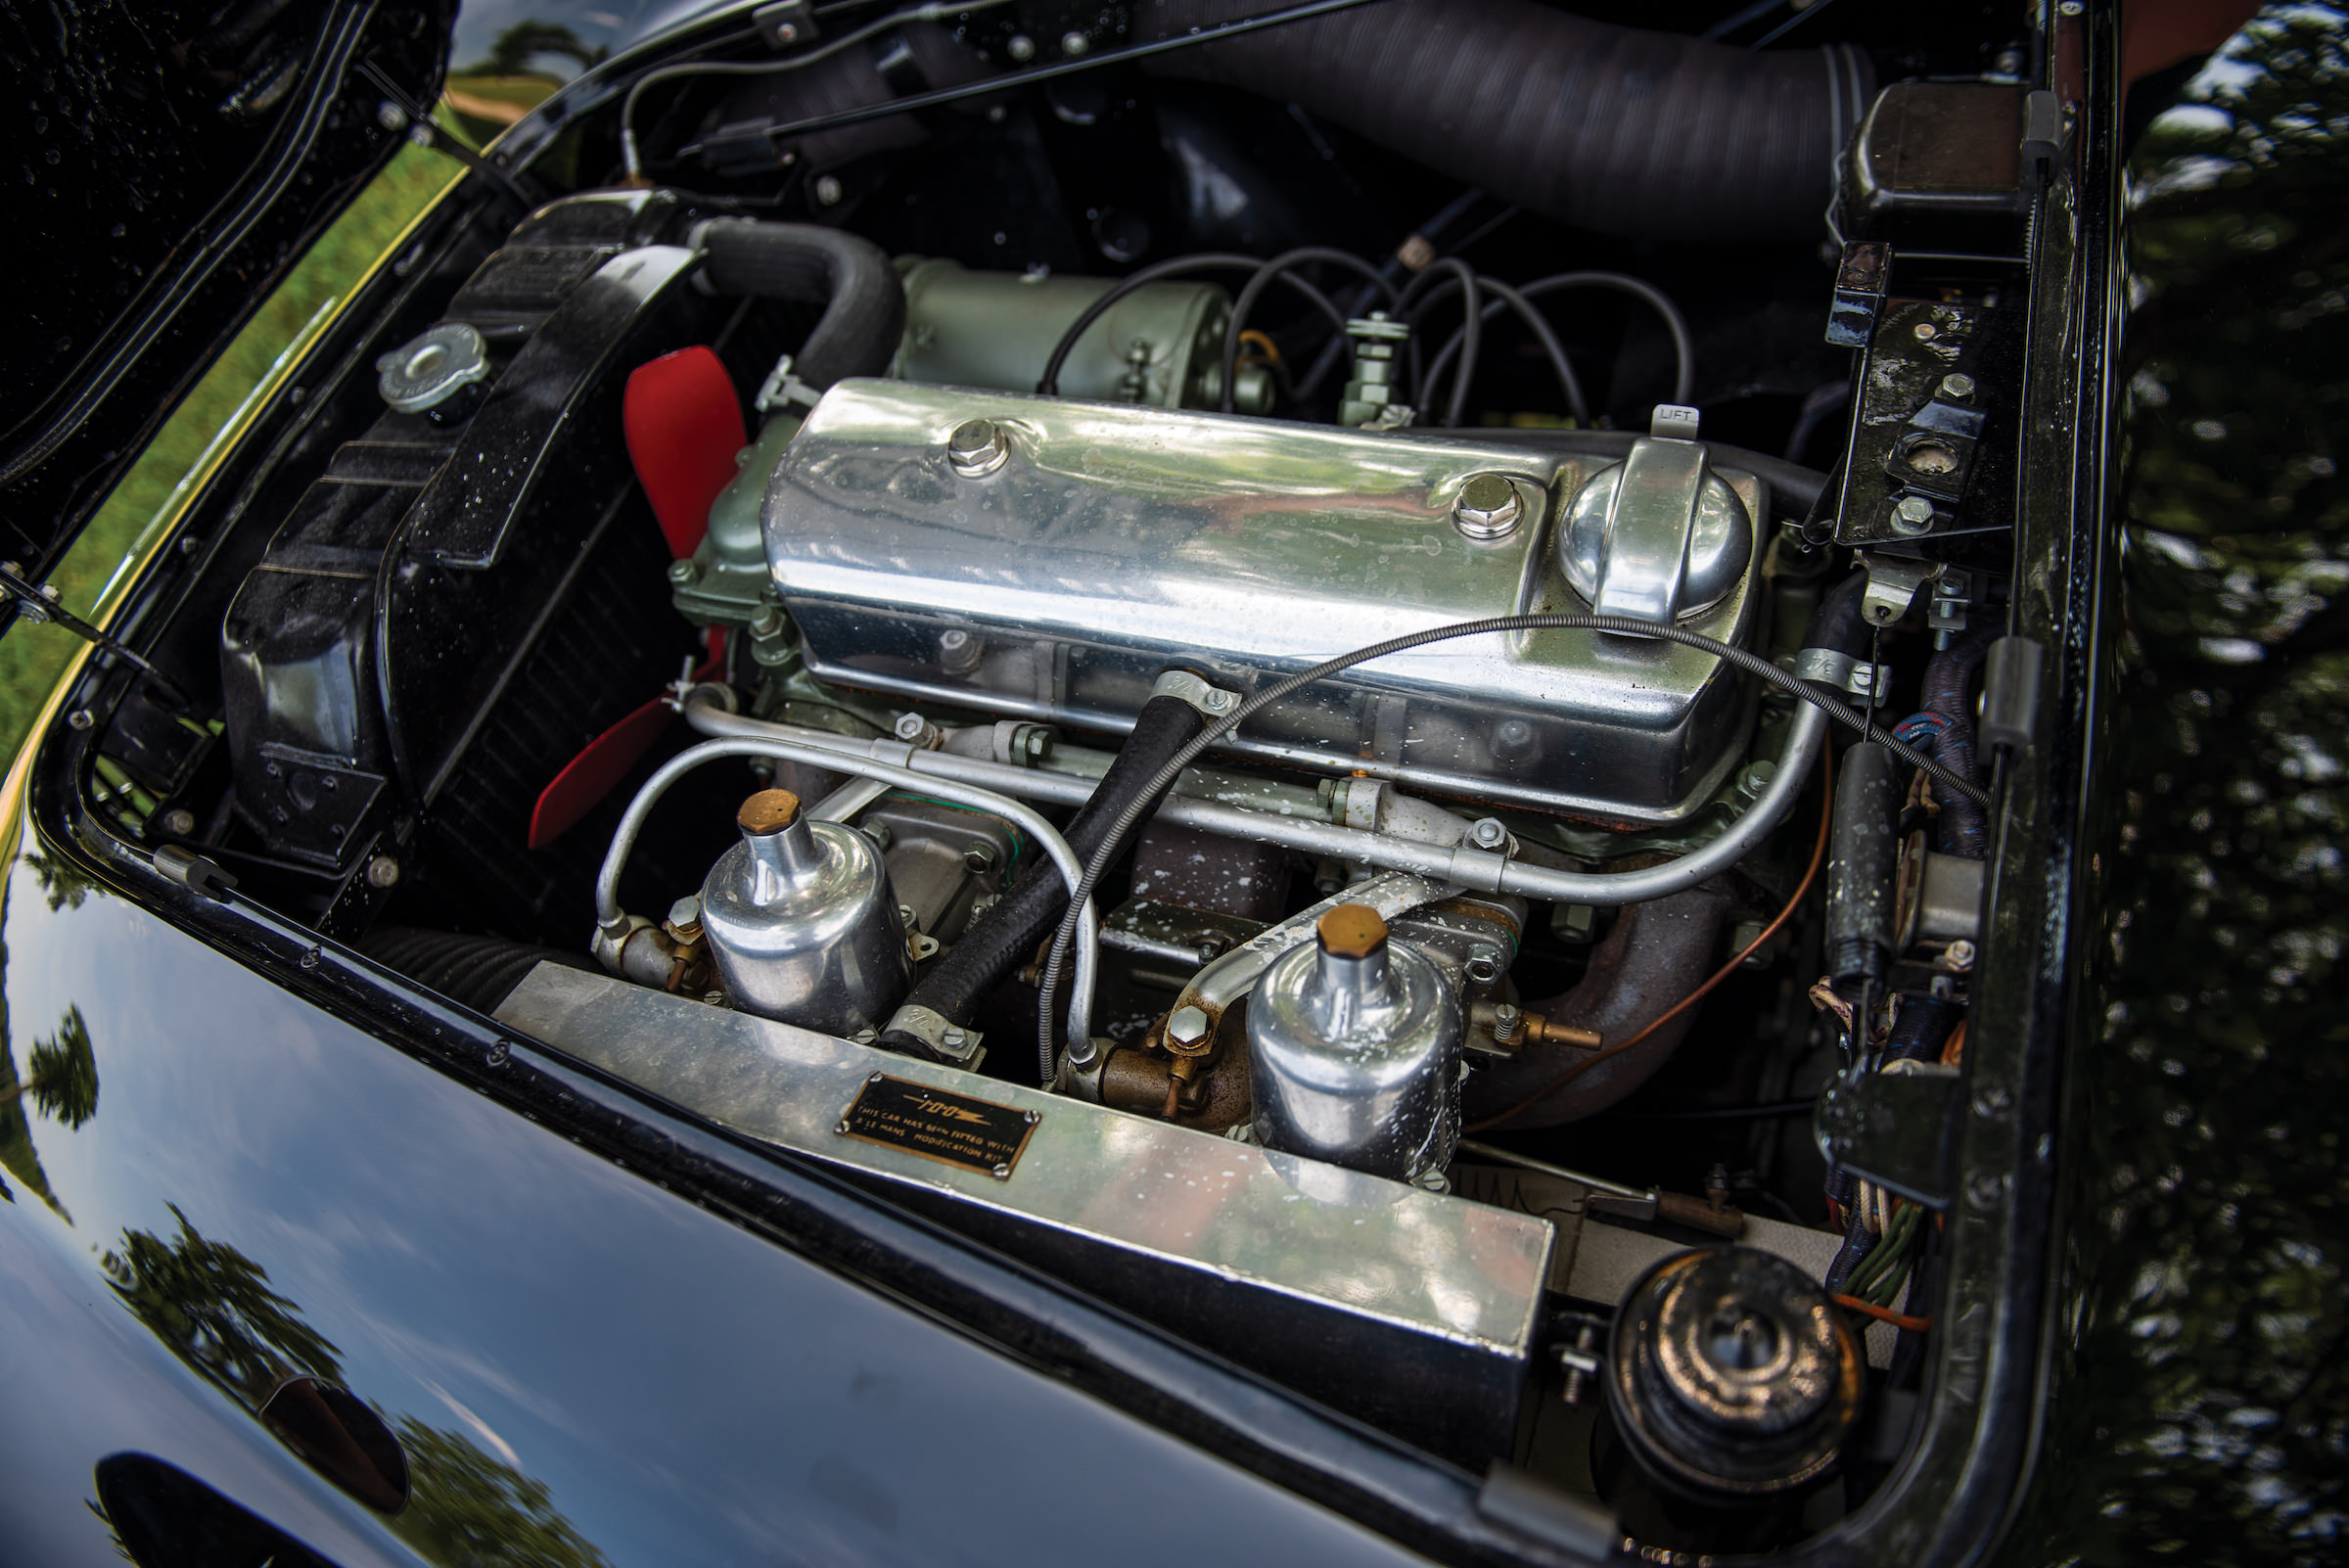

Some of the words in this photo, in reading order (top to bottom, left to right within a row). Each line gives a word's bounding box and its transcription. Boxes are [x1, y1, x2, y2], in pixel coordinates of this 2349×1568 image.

[1659, 407, 1692, 422] LIFT
[857, 1106, 879, 1117] THIS
[881, 1112, 900, 1123] CAR
[903, 1118, 923, 1129] HAS
[950, 1130, 984, 1145] FITTED
[988, 1140, 1015, 1153] WITH
[880, 1124, 905, 1136] MANS
[914, 1133, 982, 1158] MODIFICATION
[985, 1152, 1003, 1163] KIT
